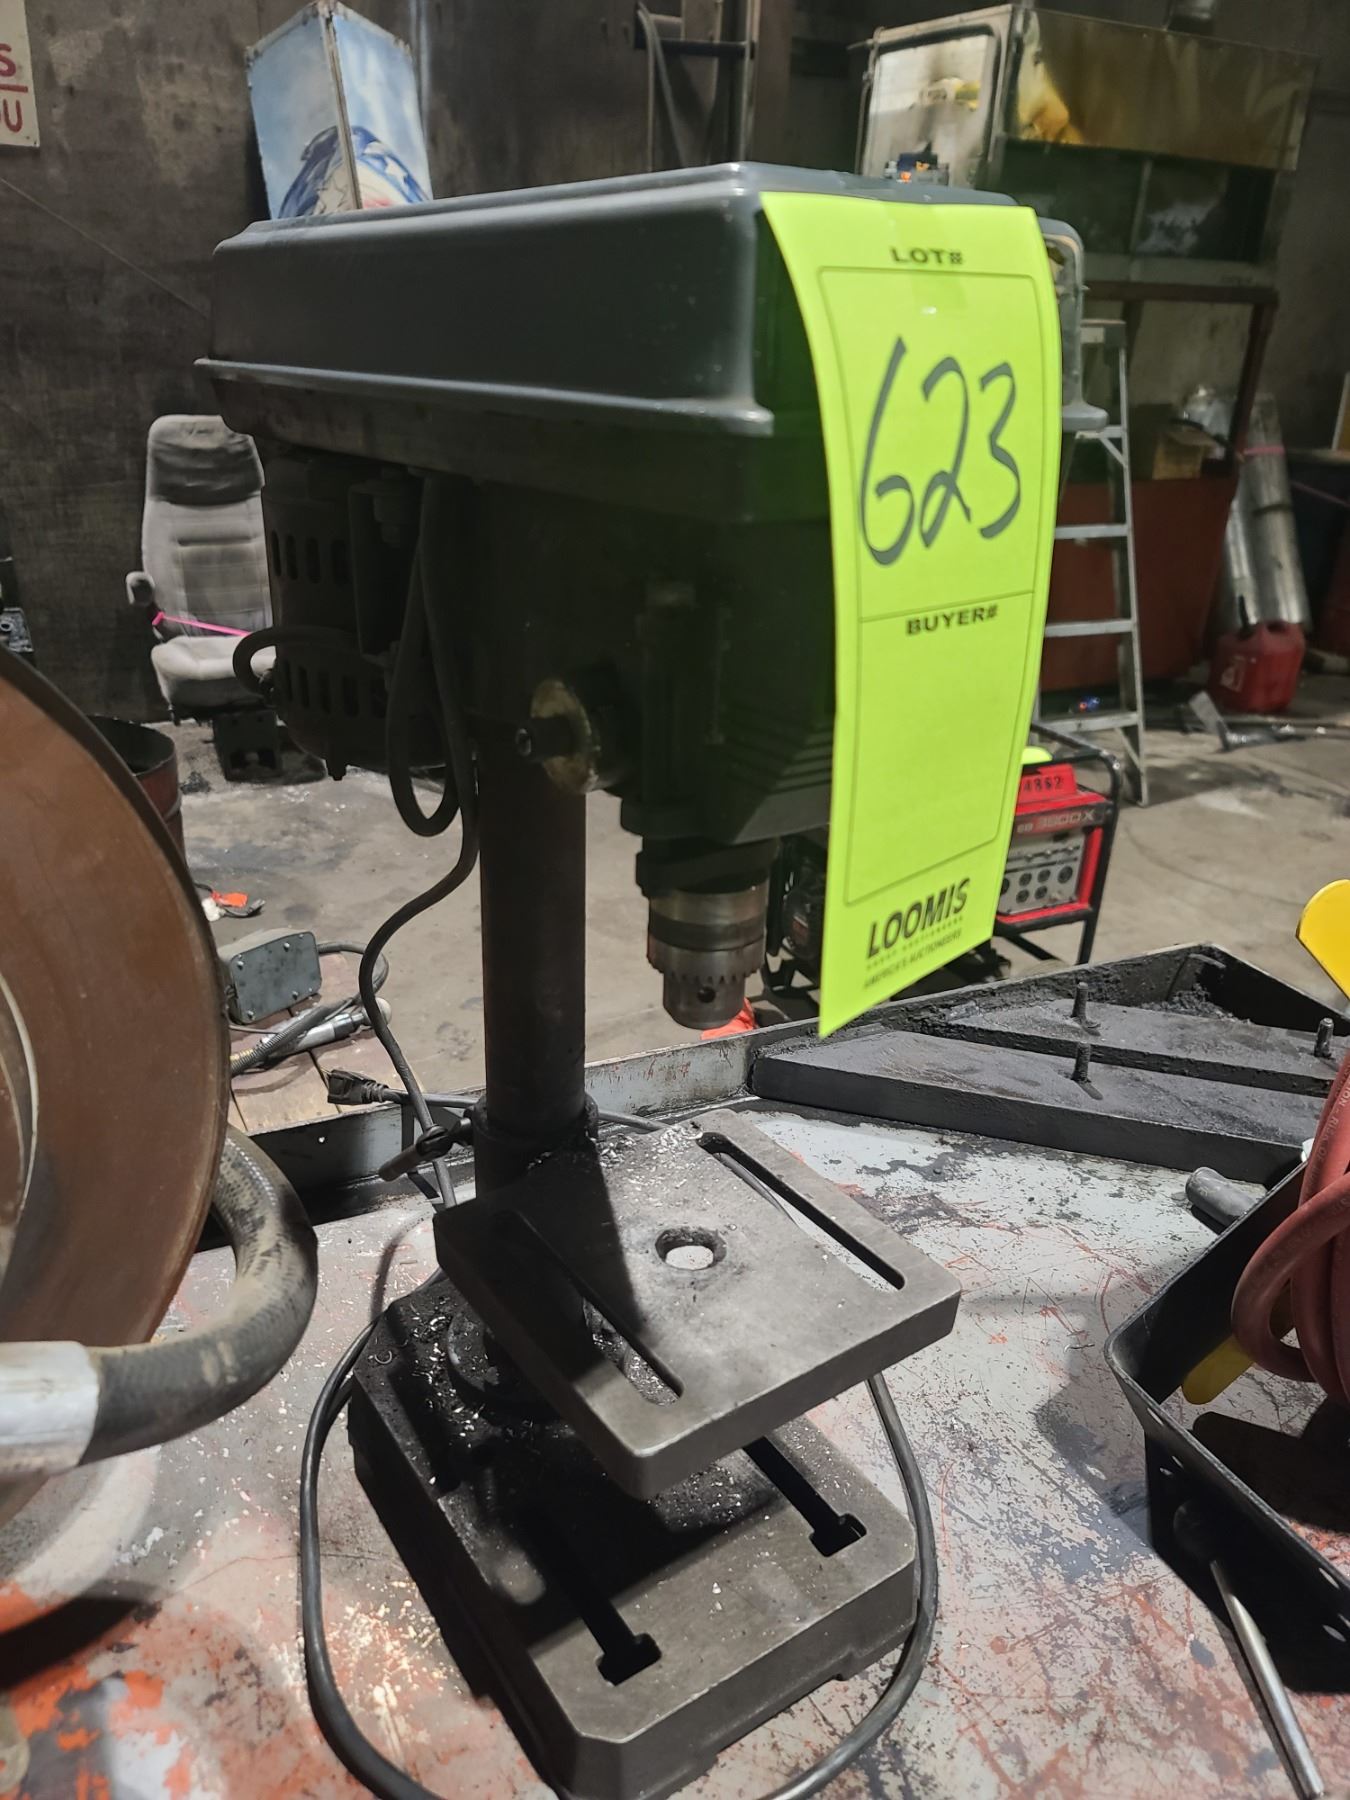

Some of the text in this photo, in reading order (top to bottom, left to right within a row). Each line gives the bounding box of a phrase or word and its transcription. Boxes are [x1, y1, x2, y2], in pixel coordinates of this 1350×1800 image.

[0, 98, 23, 133] U
[890, 246, 963, 265] LOT#
[860, 334, 1021, 567] 623
[905, 604, 999, 636] BUYER#
[867, 877, 970, 959] LOOMIS
